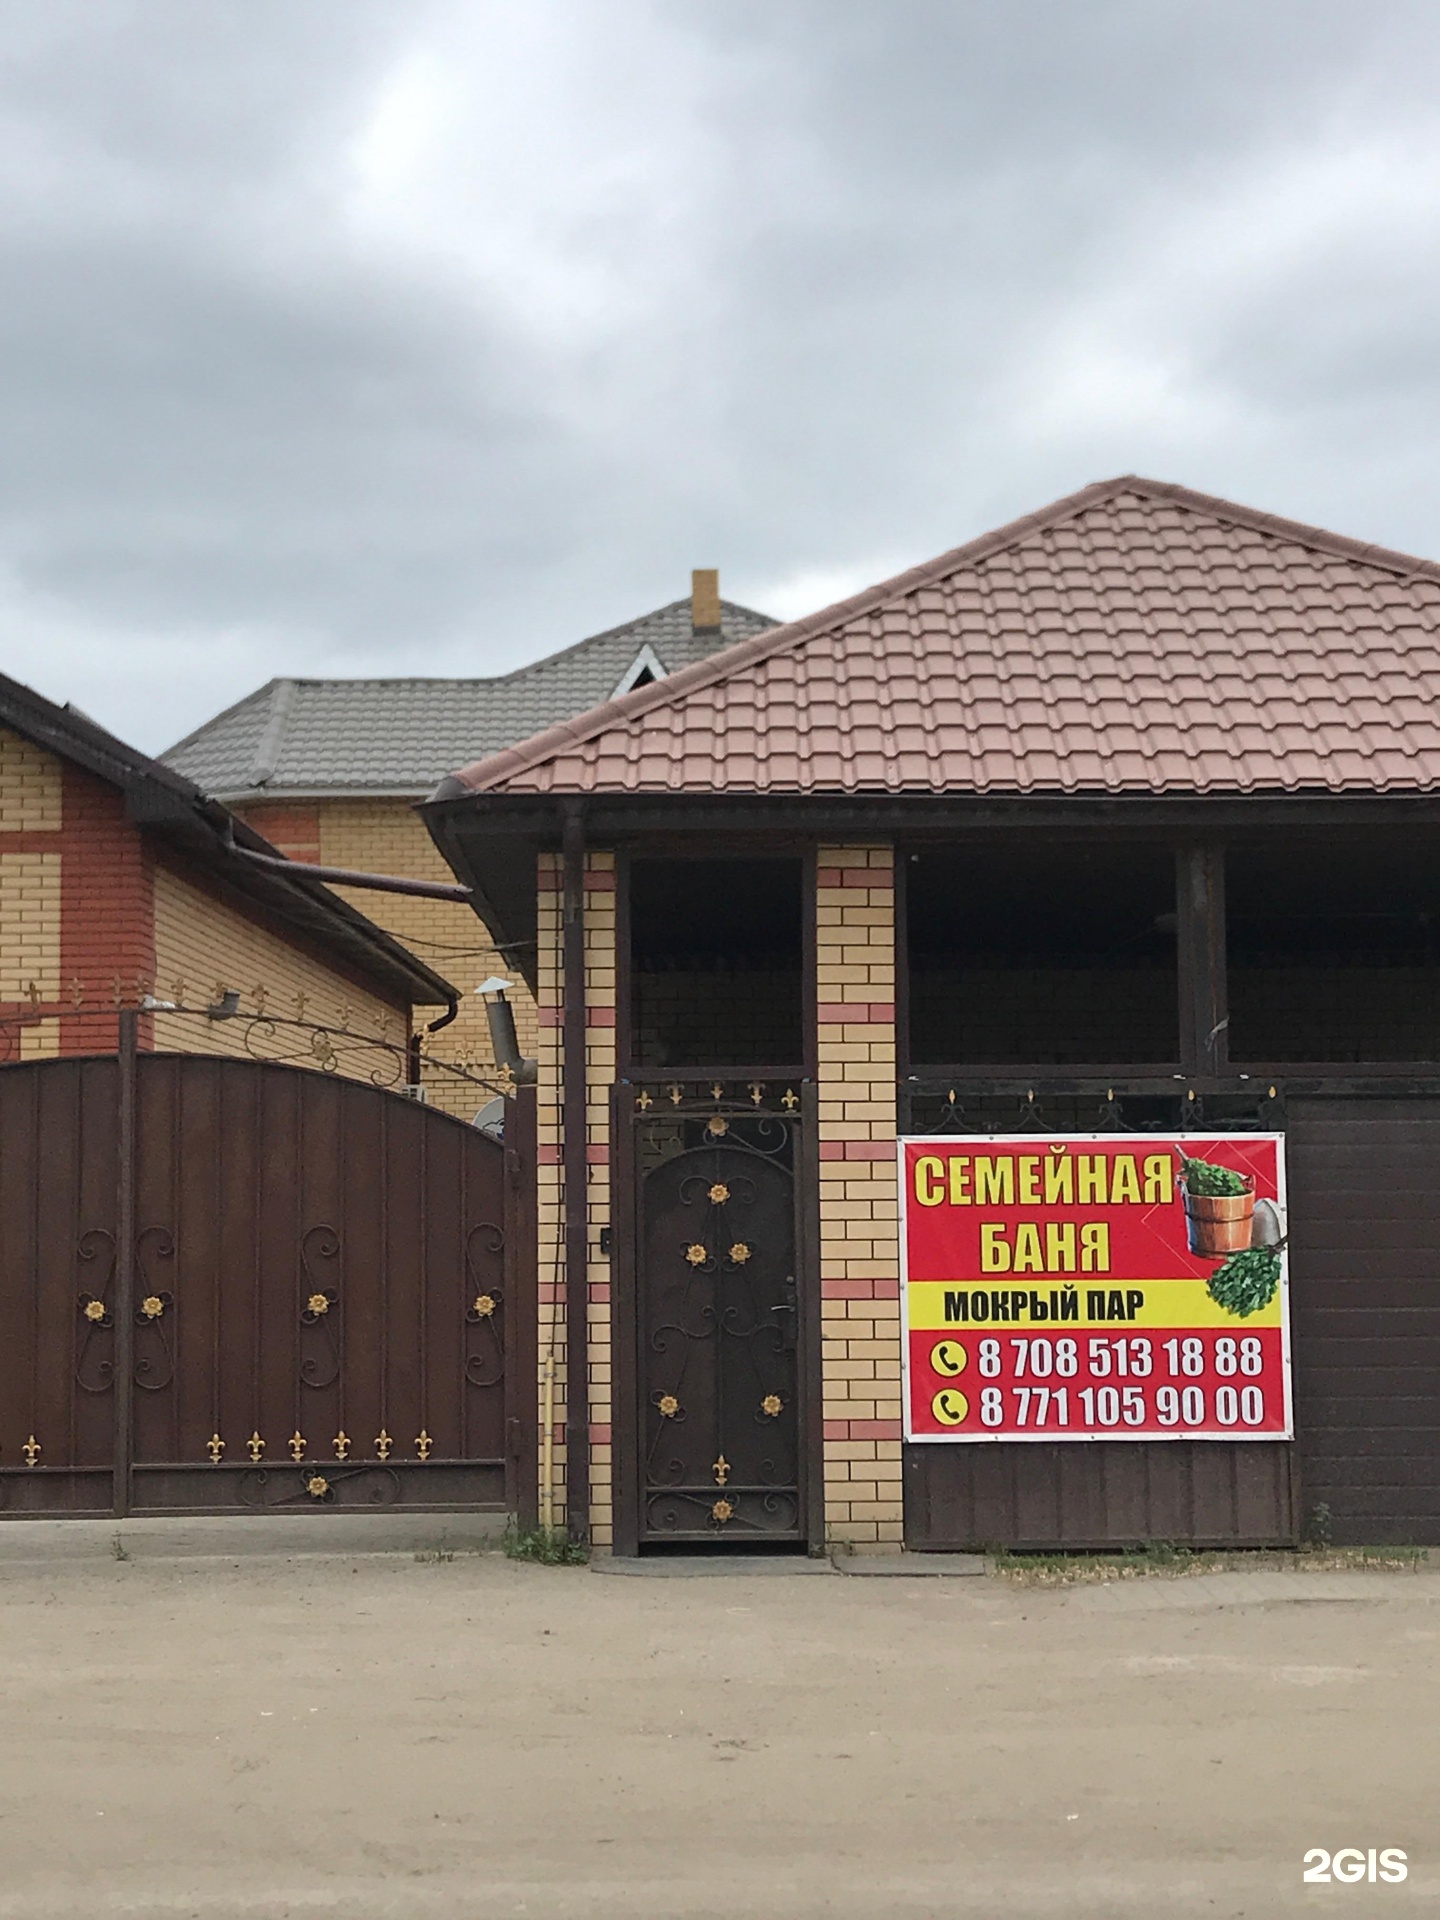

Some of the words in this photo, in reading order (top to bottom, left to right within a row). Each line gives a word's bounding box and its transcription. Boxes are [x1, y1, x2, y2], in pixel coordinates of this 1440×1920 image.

[914, 1144, 1174, 1206] СЕМЕЙНАЯ
[980, 1222, 1110, 1273] БАНЯ
[944, 1284, 1079, 1322] МОКРЫЙ
[1086, 1290, 1144, 1321] ПАР
[979, 1339, 1001, 1378] 8
[1010, 1338, 1078, 1377] 708
[1089, 1338, 1152, 1377] 513
[1162, 1338, 1204, 1376] 18
[1215, 1337, 1262, 1376] 88
[980, 1387, 1003, 1426] 8
[1012, 1387, 1068, 1426] 771
[1078, 1386, 1145, 1426] 105
[1156, 1386, 1205, 1425] 90
[1216, 1385, 1264, 1425] 00
